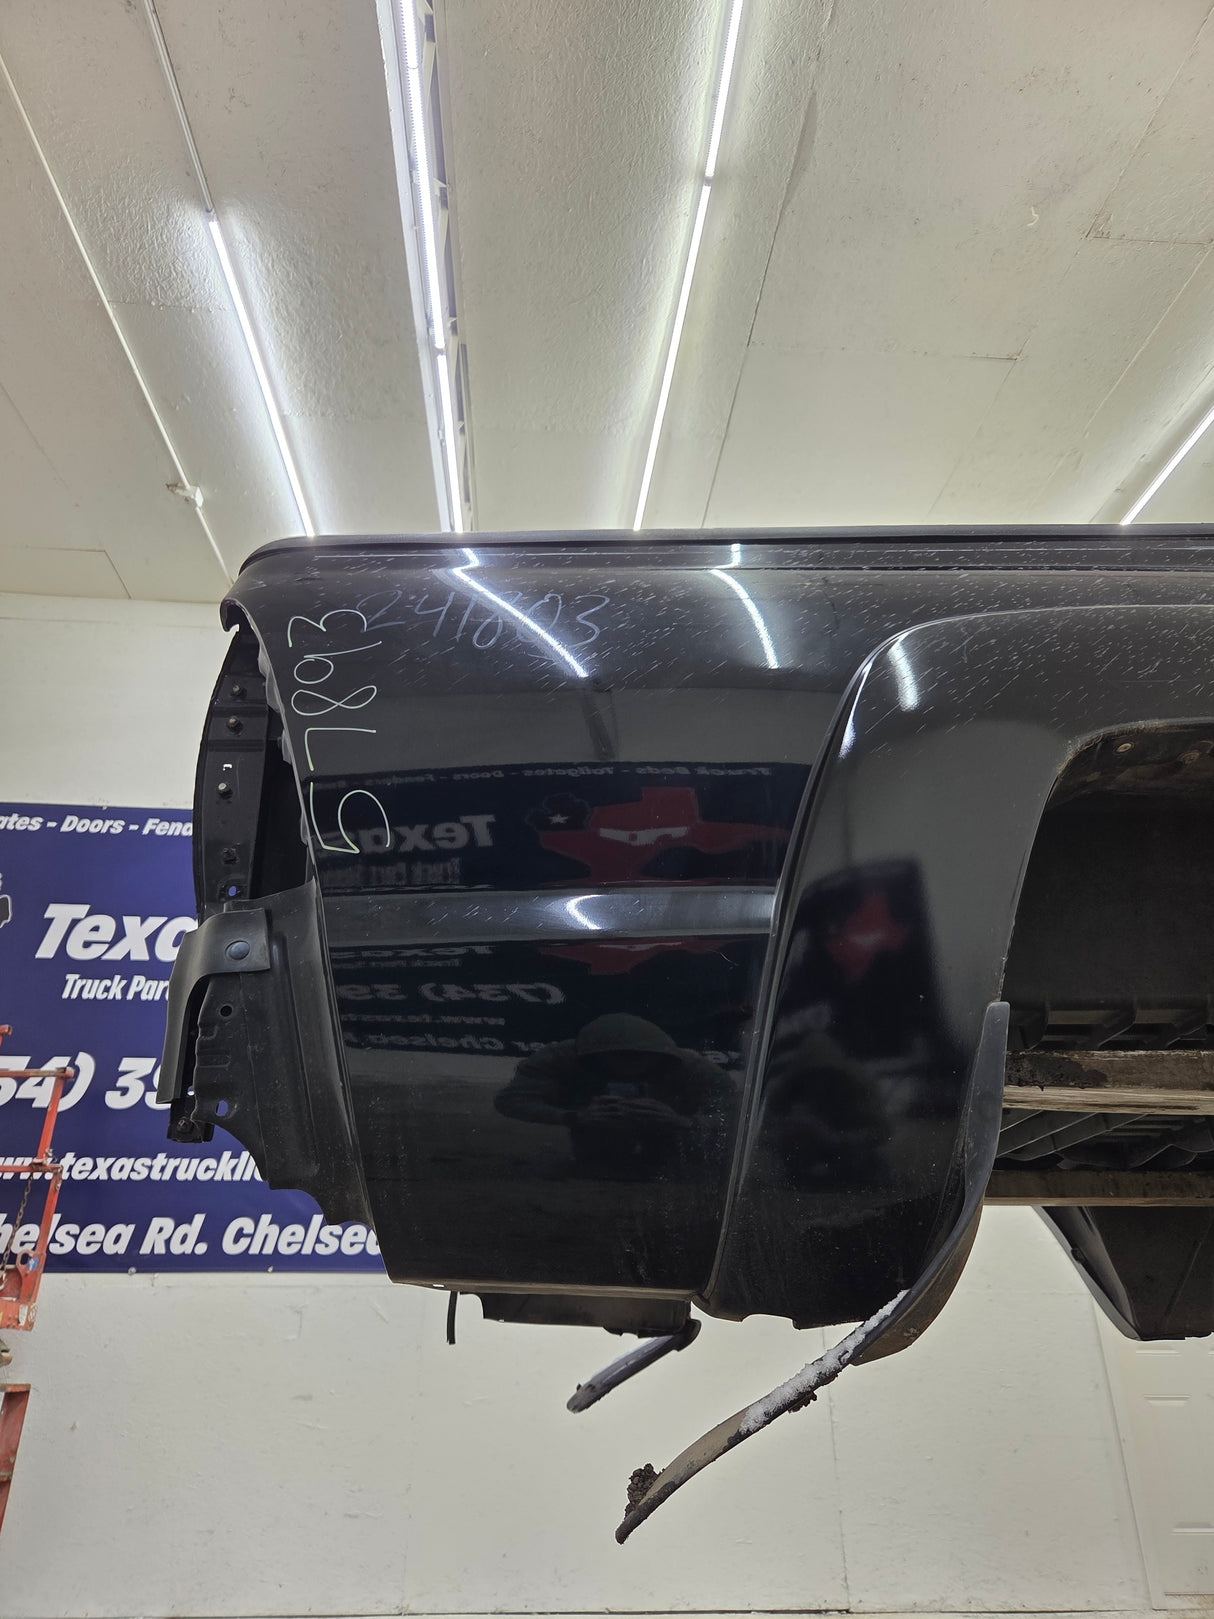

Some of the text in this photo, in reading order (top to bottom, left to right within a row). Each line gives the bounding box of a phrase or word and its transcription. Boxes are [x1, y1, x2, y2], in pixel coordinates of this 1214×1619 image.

[60, 815, 125, 834] Doors
[62, 974, 127, 1000] Truck
[105, 1057, 172, 1110] 3
[139, 1213, 208, 1255] Rd.
